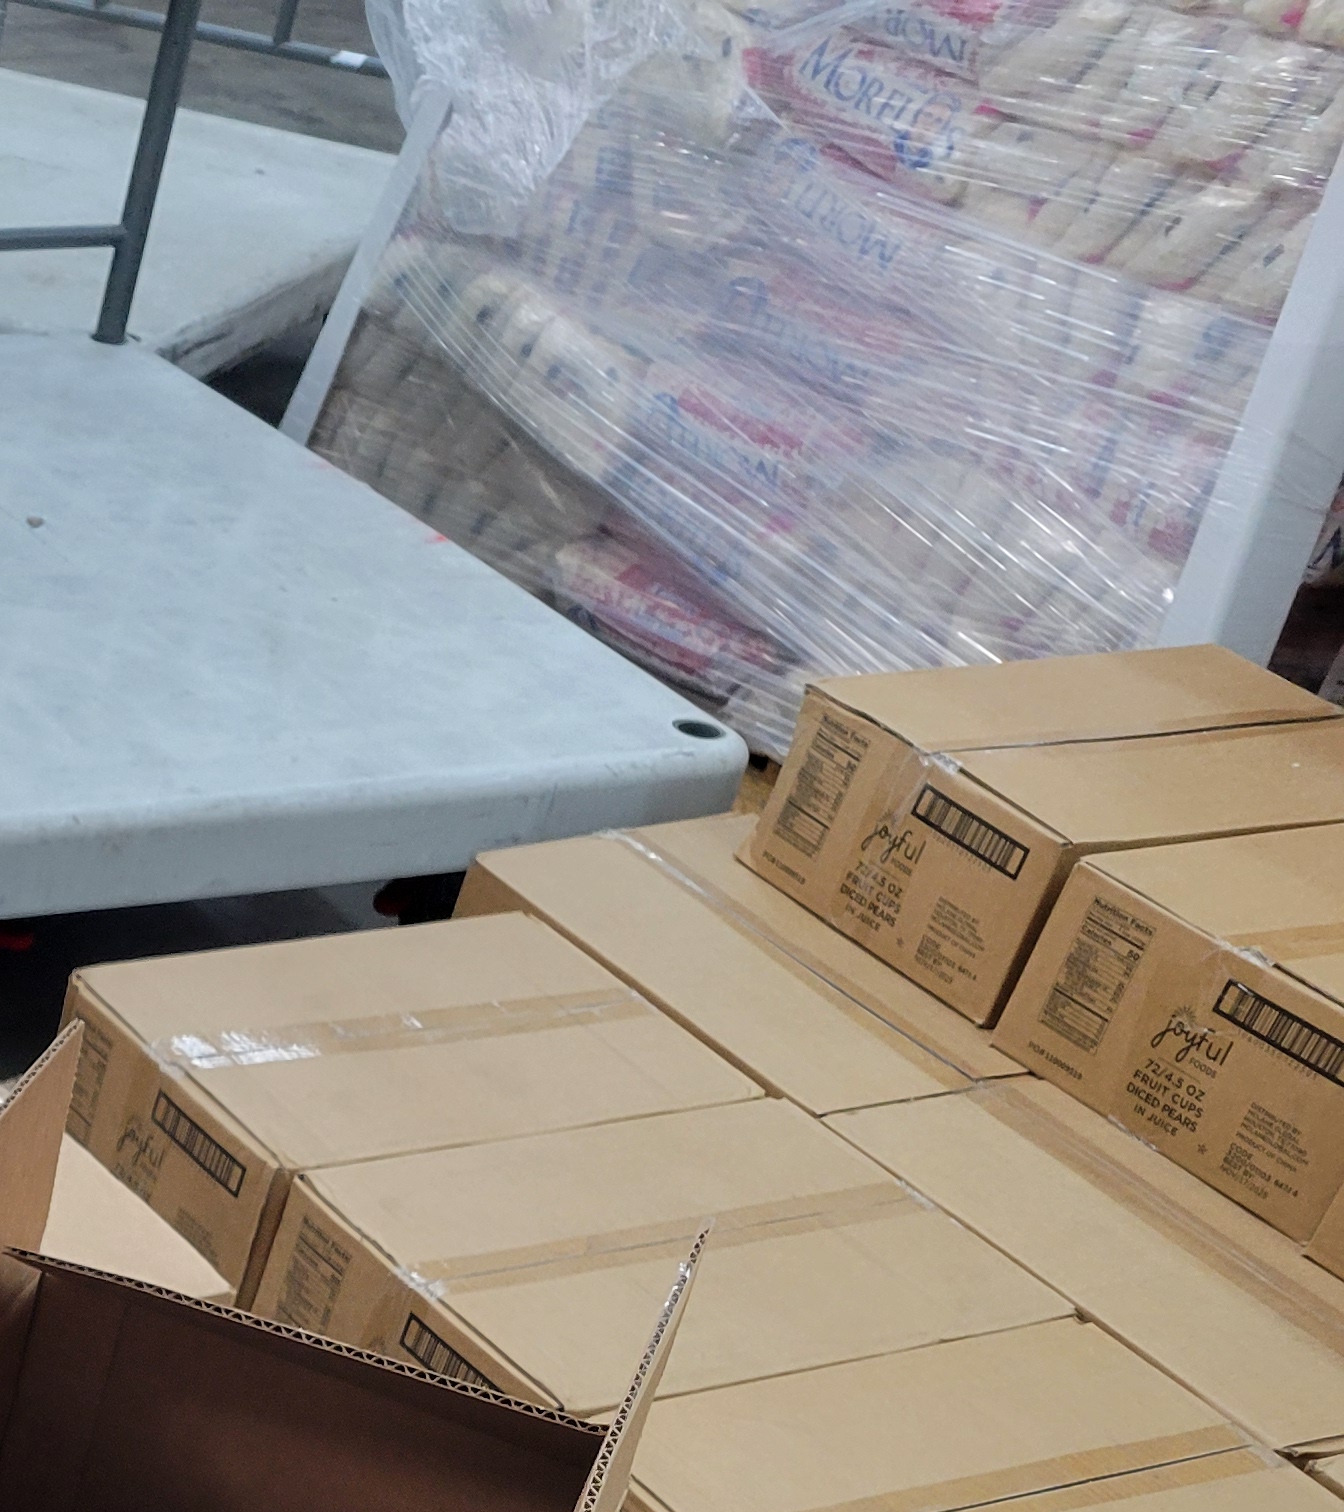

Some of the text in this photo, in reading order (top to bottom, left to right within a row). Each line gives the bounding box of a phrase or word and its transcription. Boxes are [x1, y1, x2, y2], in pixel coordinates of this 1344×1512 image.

[861, 822, 924, 866] joyful
[839, 883, 897, 927] DICED PEARS
[845, 870, 901, 913] FRUIT CUPS
[886, 881, 903, 898] OZ
[856, 910, 880, 931] JUICE
[1149, 1012, 1233, 1067] joyful
[1132, 1068, 1203, 1120] FRUIT CUPS
[1144, 1058, 1204, 1102] 72/4.5 OZ
[1126, 1081, 1197, 1134] DICED PEARS
[1133, 1103, 1177, 1137] IN JUICE
